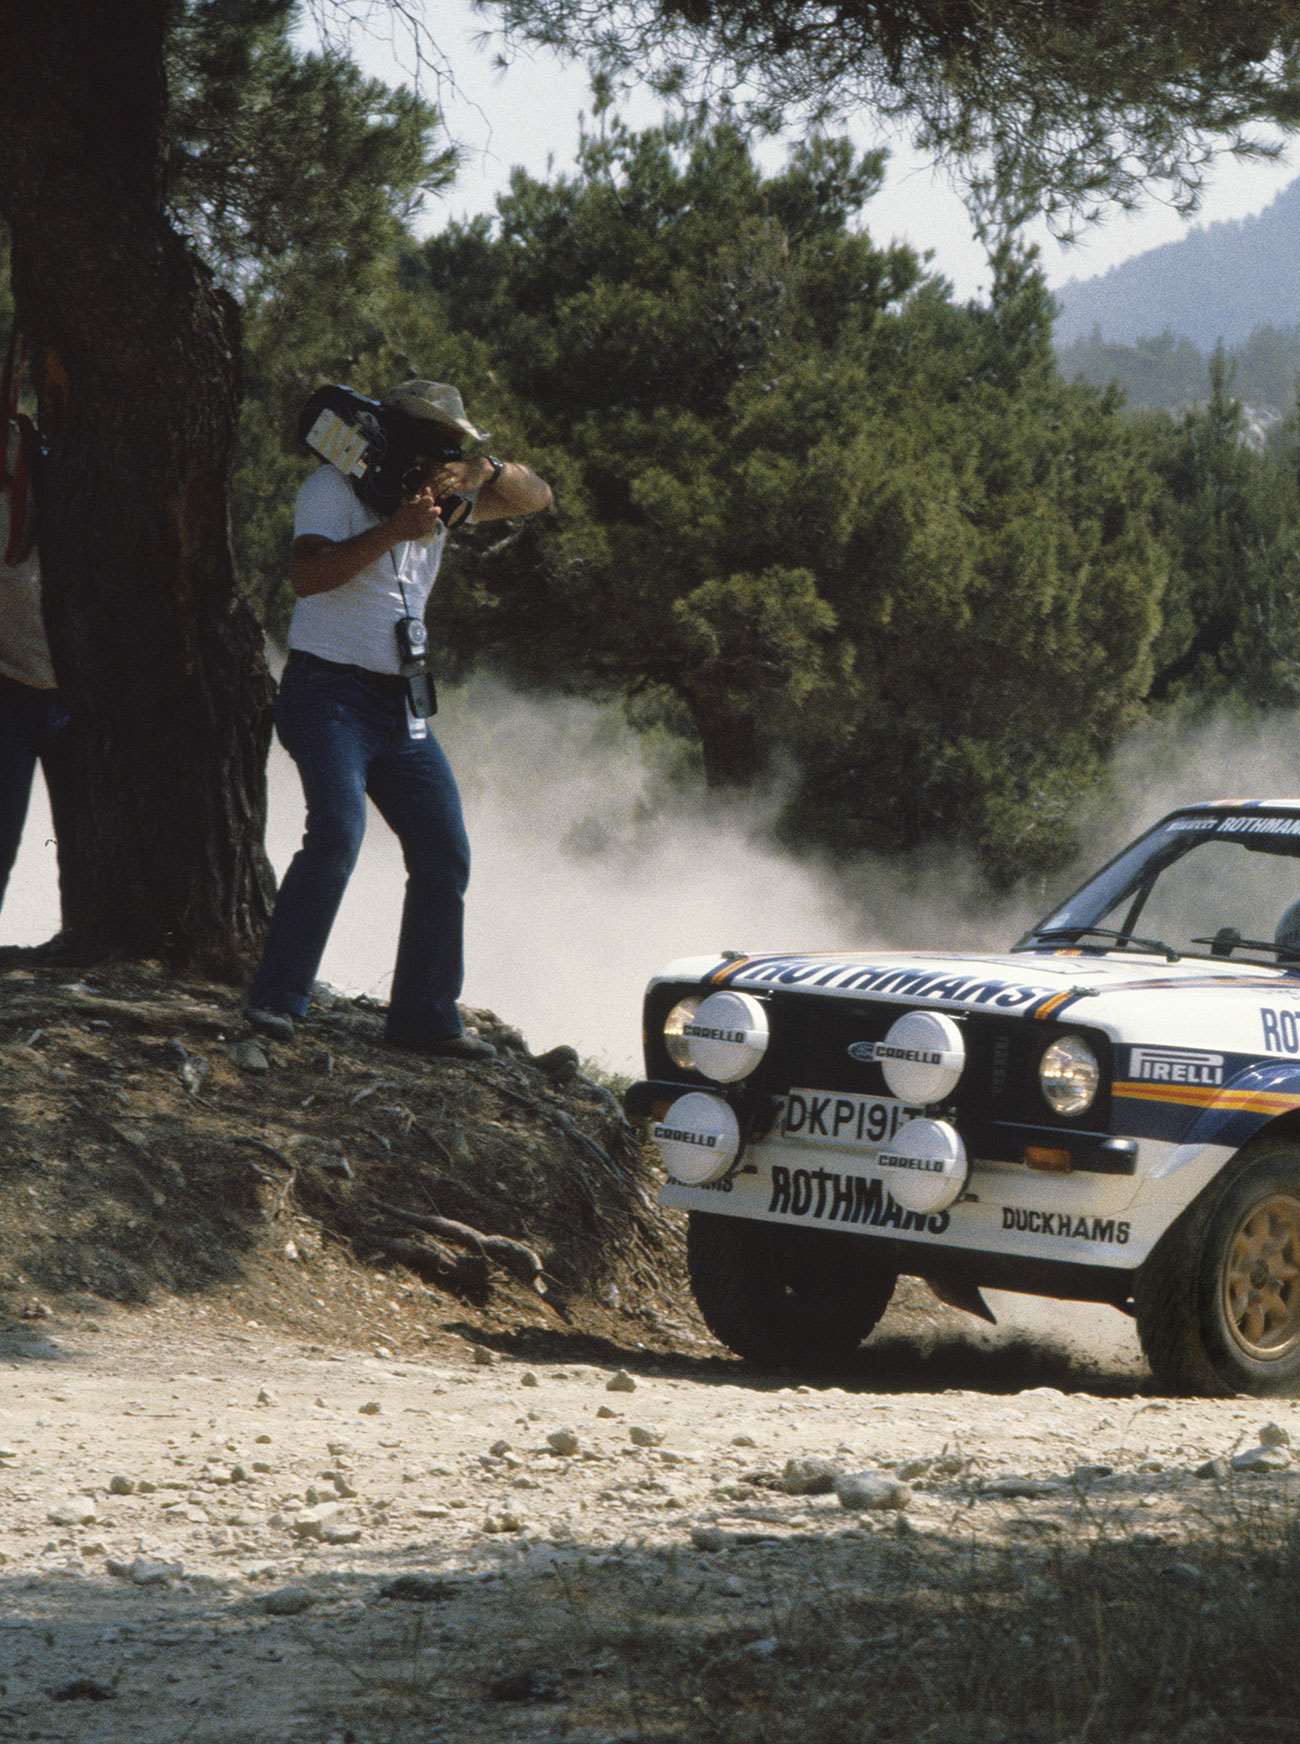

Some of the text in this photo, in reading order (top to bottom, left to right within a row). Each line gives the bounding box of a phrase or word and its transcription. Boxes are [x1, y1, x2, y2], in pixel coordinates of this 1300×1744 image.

[744, 961, 1053, 1006] ROTHMANS
[683, 1024, 745, 1043] CARELLO
[876, 1045, 942, 1064] CARELLO
[1128, 1047, 1224, 1085] PIRELLI
[655, 1127, 716, 1147] CARELLO
[878, 1154, 944, 1173] CARELLO
[1002, 1206, 1131, 1245] DUCKHAMS
